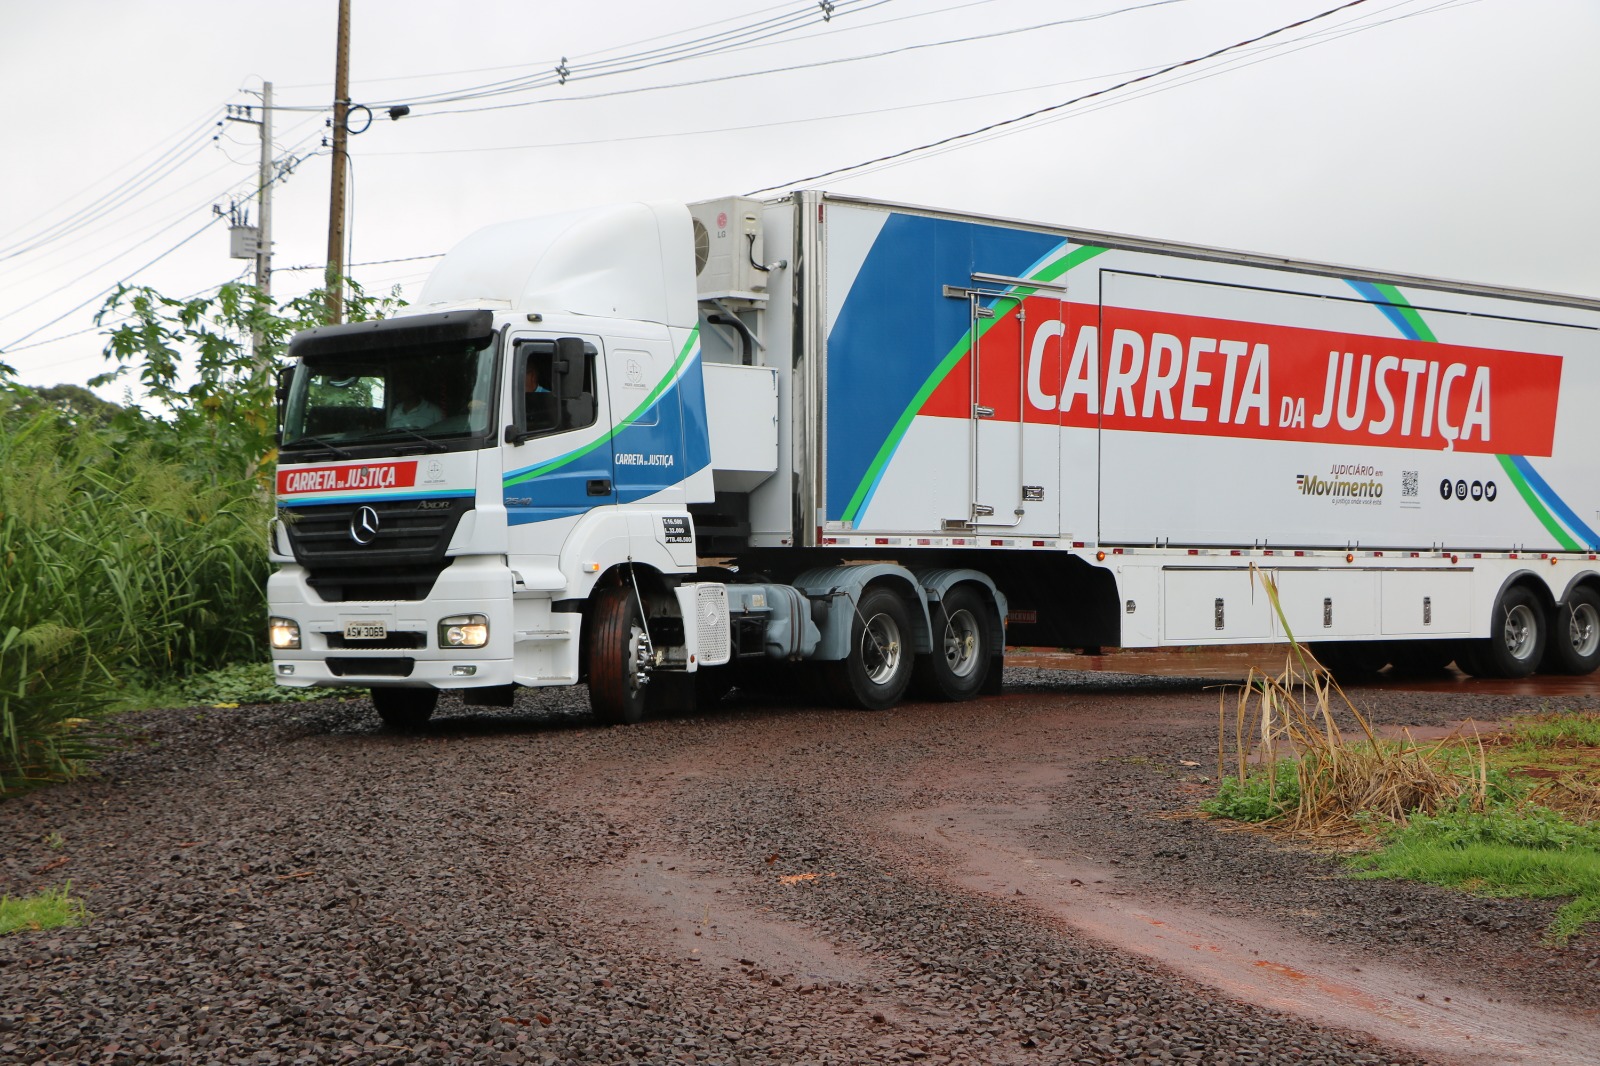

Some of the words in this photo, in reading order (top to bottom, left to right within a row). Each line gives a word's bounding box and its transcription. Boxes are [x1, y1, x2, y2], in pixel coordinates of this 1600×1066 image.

[717, 230, 726, 239] LG
[1027, 319, 1270, 427] CARRETA
[1278, 396, 1306, 429] DA
[1311, 350, 1491, 452] JUSTIÇA
[615, 453, 643, 466] CARRETA
[648, 454, 673, 468] JUSTIÇA
[1330, 464, 1374, 476] JUDICIÁRIO
[286, 470, 336, 492] CARRETA
[337, 480, 345, 488] DA
[1302, 475, 1383, 498] Movimento
